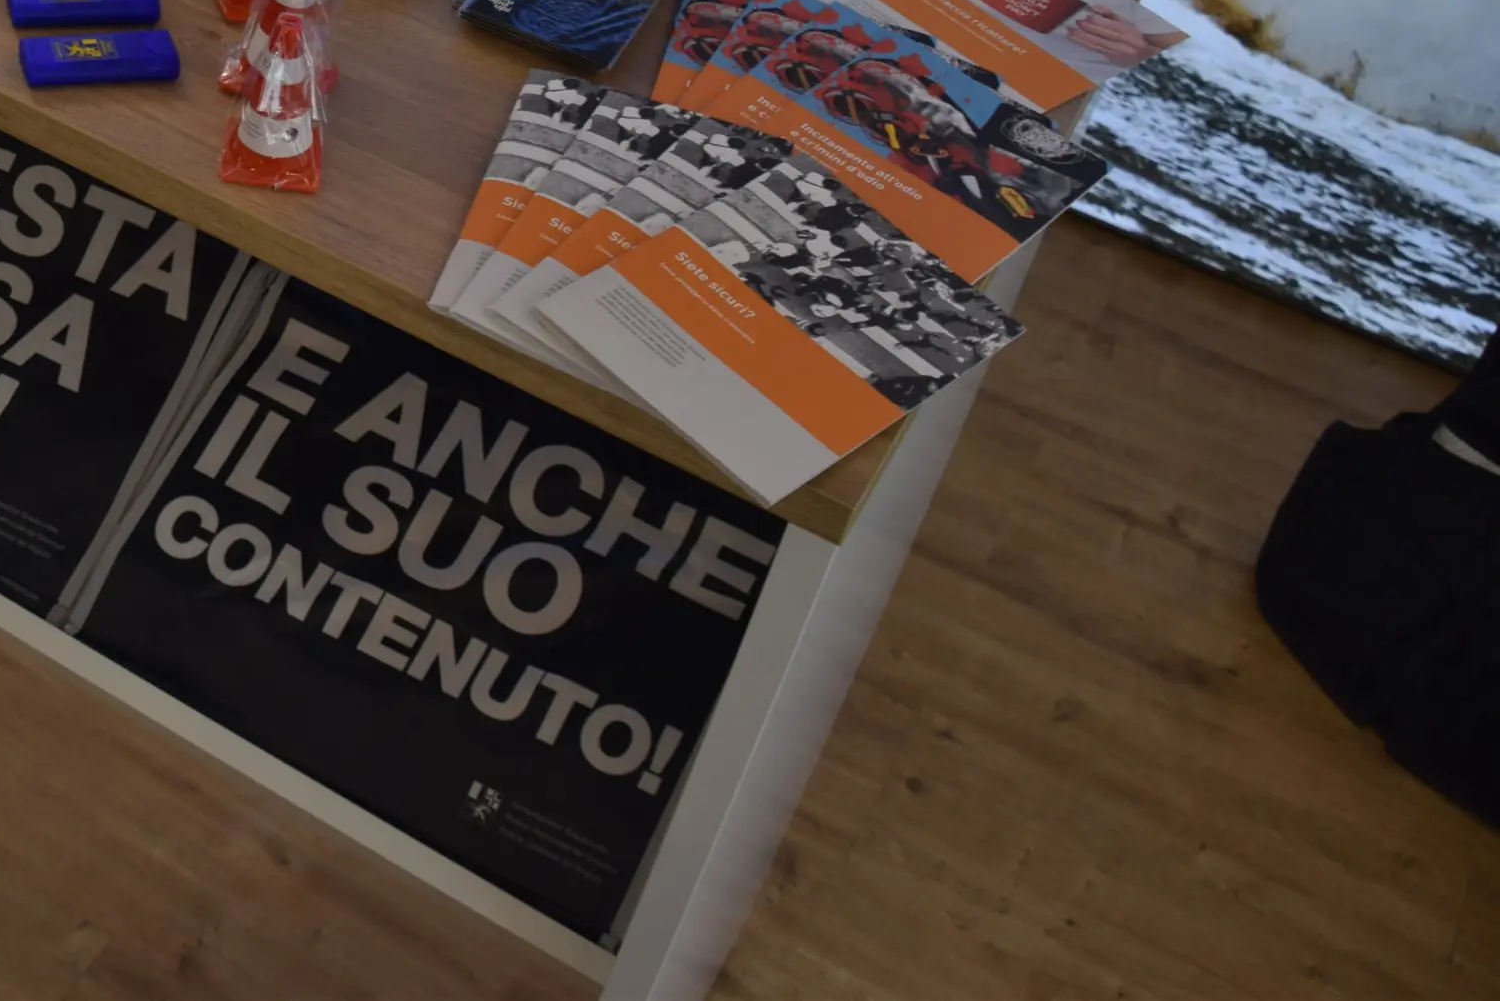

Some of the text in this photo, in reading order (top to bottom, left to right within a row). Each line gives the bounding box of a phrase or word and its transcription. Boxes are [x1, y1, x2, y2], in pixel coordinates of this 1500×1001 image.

[789, 129, 800, 138] e
[800, 135, 848, 167] crimini
[846, 161, 885, 191] d'odio
[800, 122, 877, 172] Incitamento
[875, 167, 924, 201] all'odio
[674, 250, 757, 321] Siete sicuri?
[194, 394, 585, 636] IL SUO
[246, 317, 775, 622] E ANCHE
[153, 495, 686, 797] CONTENUTO!
